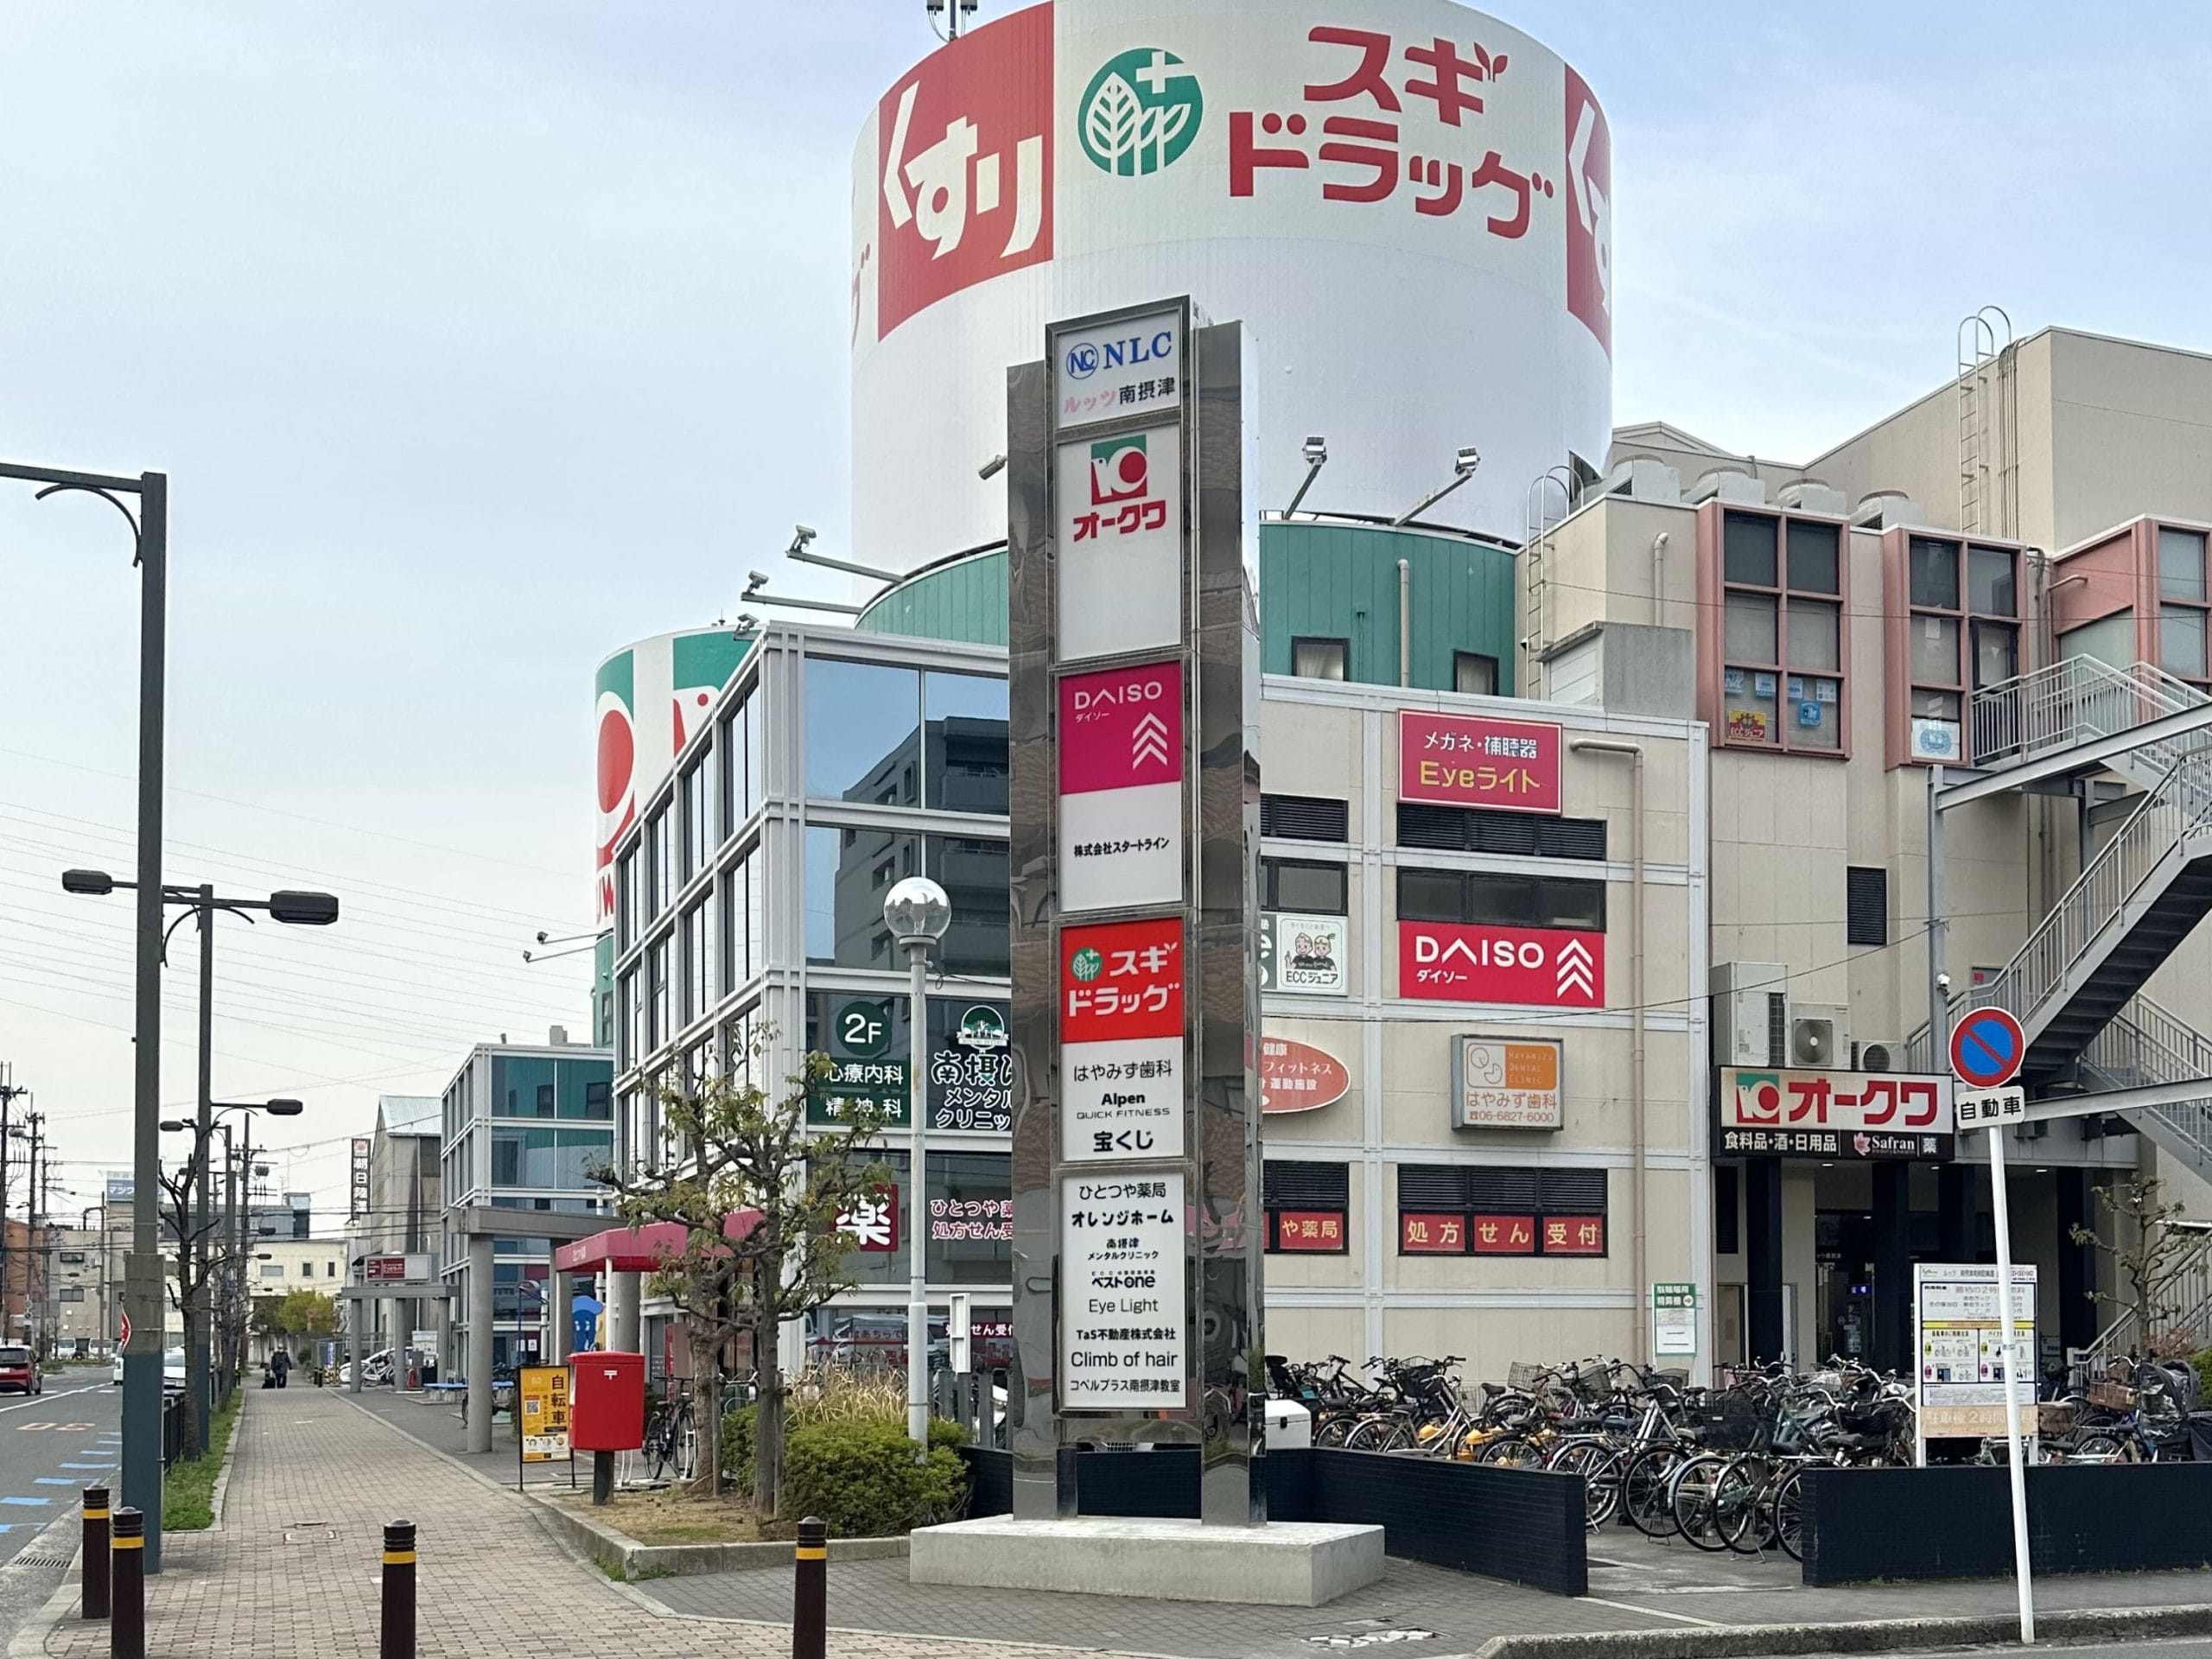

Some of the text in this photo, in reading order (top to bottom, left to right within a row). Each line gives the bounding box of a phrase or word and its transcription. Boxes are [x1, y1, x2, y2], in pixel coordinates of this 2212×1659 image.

[1304, 25, 1508, 126] スギ
[882, 79, 1043, 260] くすり
[1229, 111, 1554, 240] ドラッグ
[1103, 331, 1173, 369] NLC
[1064, 377, 1176, 414] ルッツ南摂津
[1073, 499, 1166, 543] オークワ
[1074, 681, 1163, 710] DAISO
[1075, 711, 1110, 723] ダイソー
[1424, 730, 1537, 760] メガネ・補聴器
[1420, 760, 1541, 794] Eyeライト
[1074, 836, 1170, 857] 株式会社スタートライン
[1109, 941, 1178, 976] スギ
[1415, 935, 1545, 969] DAISO
[1286, 970, 1338, 984] ECCジュニア
[1416, 969, 1468, 984] ダイソー
[1068, 982, 1180, 1017] ドラッグ
[844, 1013, 883, 1044] 2F
[824, 1062, 904, 1085] 心療内科
[1073, 1058, 1173, 1082] はやみず歯科
[1264, 1062, 1332, 1074] フィットネス
[1101, 1093, 1146, 1108] Alpen
[1466, 1091, 1557, 1109] はやみず歯科
[1789, 1078, 1937, 1127] オークワ
[1960, 1096, 2022, 1121] 自動車
[1077, 1108, 1171, 1120] QUICK FITNESS
[1093, 1129, 1154, 1153] 宝くじ
[1725, 1131, 1838, 1153] 食料品・酒・日用品
[1872, 1135, 1915, 1150] Safran
[1079, 1182, 1166, 1200] ひとつや薬局
[1071, 1209, 1174, 1228] オレンジホーム
[1282, 1219, 1339, 1239] や薬局
[1087, 1250, 1159, 1261] メンタルクリニック
[1091, 1276, 1156, 1288] ベストone
[1088, 1298, 1160, 1314] Eye Light
[1076, 1327, 1176, 1340] TaS不動産株式会社
[1071, 1351, 1179, 1367] Climb of hair
[550, 1375, 567, 1425] 自転車
